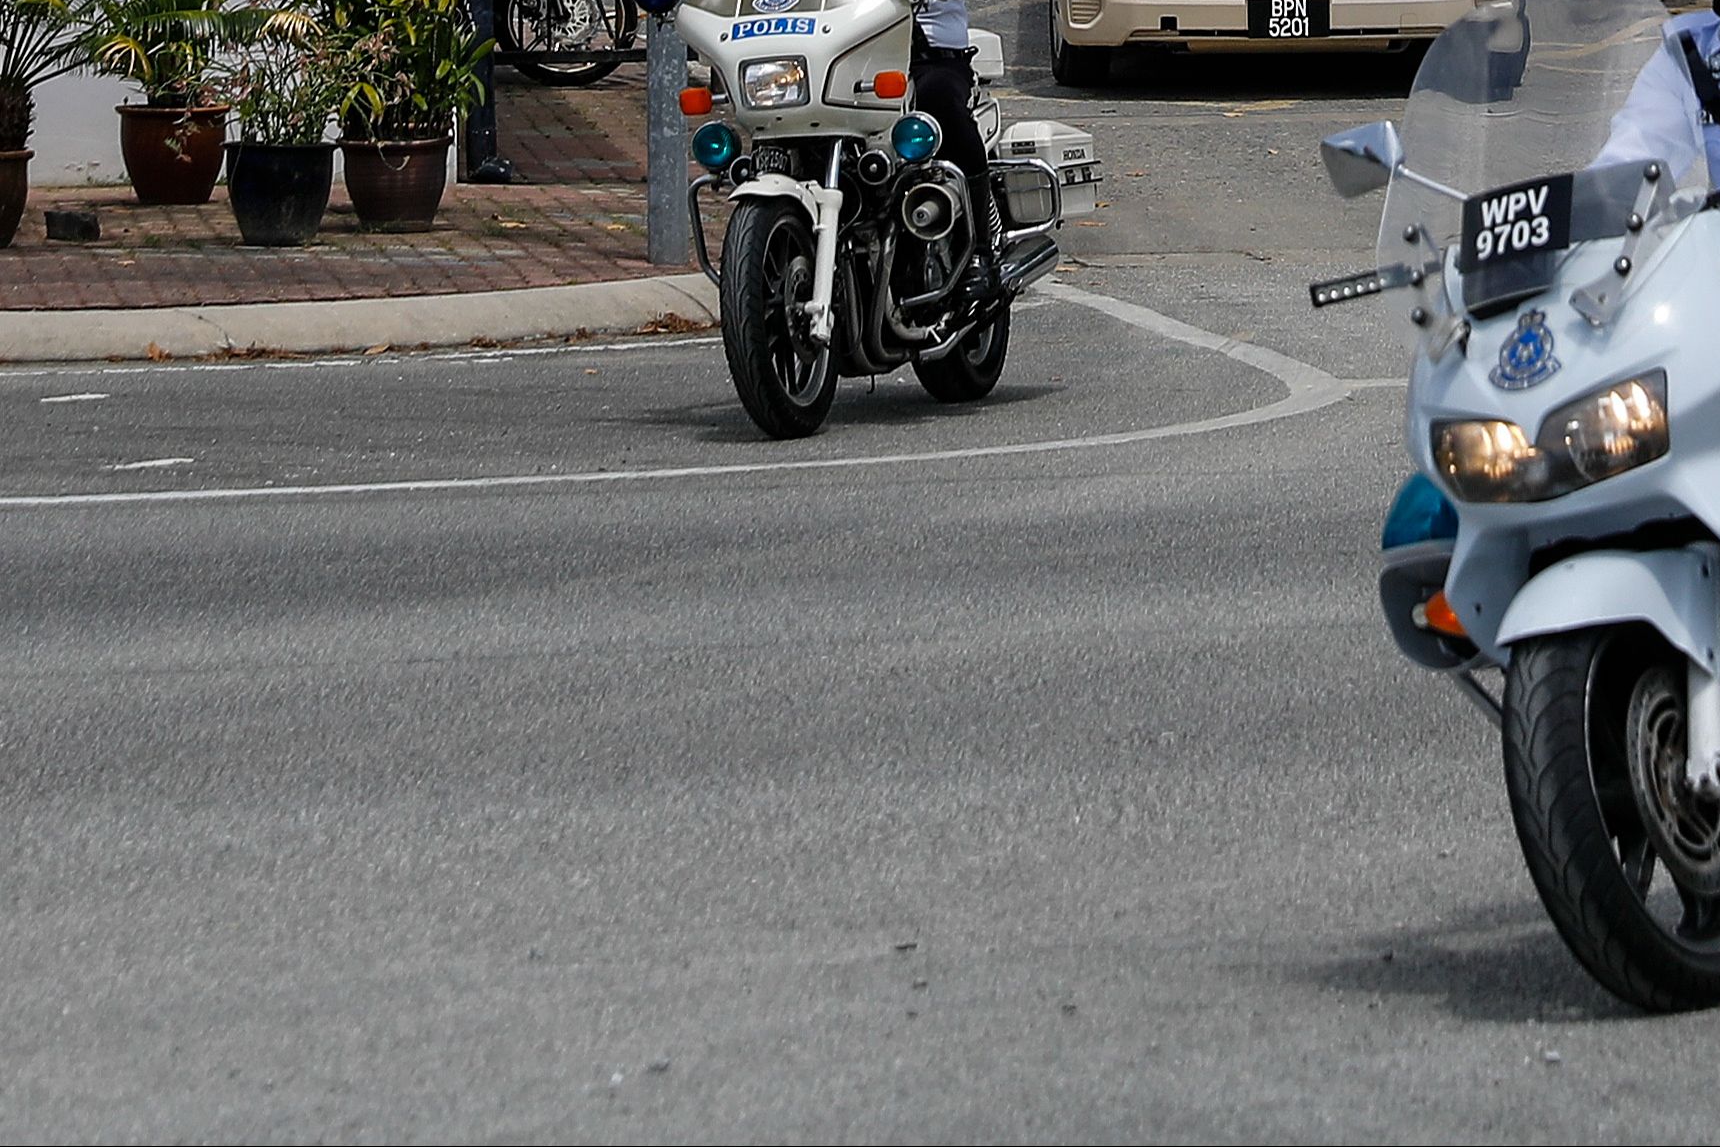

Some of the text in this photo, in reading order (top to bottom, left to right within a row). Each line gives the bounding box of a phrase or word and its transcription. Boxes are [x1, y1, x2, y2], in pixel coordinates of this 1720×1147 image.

[737, 19, 810, 38] POLIS
[1268, 17, 1309, 37] 5201
[1481, 185, 1549, 228] WPV
[1476, 216, 1550, 261] 9703
